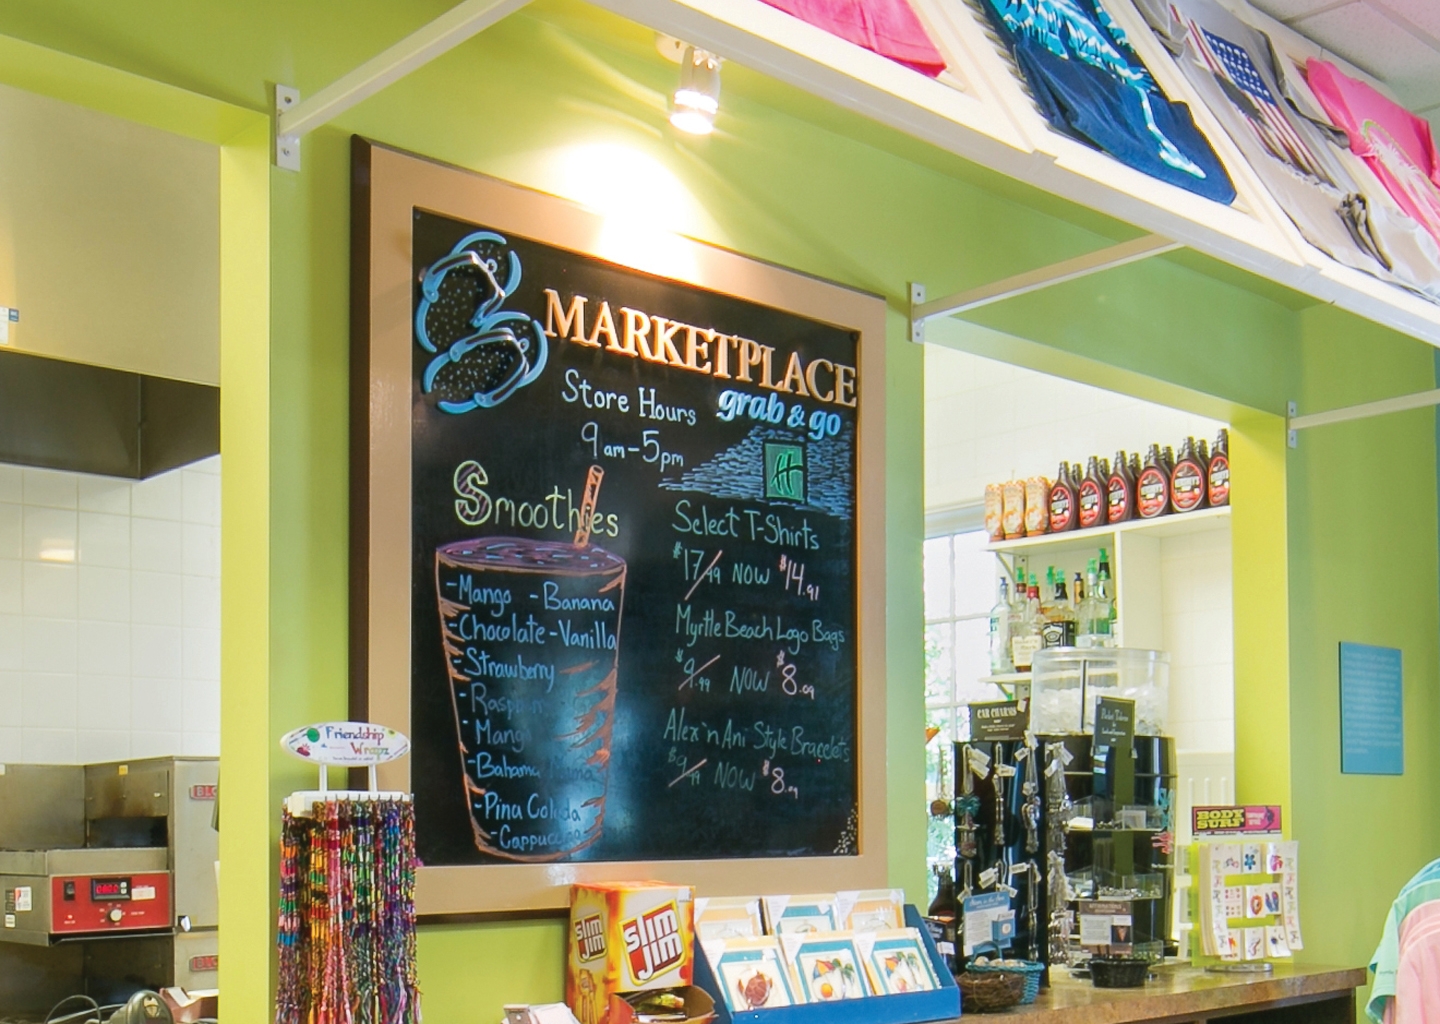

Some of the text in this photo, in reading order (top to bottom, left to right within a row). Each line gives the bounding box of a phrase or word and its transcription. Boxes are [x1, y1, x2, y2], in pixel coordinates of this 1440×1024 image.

[544, 288, 857, 408] MARKETPLACE
[562, 369, 696, 426] Store Hours
[717, 389, 841, 440] grab & go
[453, 460, 619, 539] Smoothies
[672, 499, 820, 550] Select T-Shirts
[732, 562, 770, 585] NOW
[675, 603, 846, 655] Myrtle Beach Logo Bags
[729, 665, 771, 695] NOW
[976, 706, 990, 719] CAR
[325, 726, 384, 746] Friendship
[664, 707, 699, 743] Alex
[722, 718, 748, 749] Ani
[753, 720, 788, 760] Style
[792, 725, 850, 763] Bracelets
[350, 742, 389, 760] Wrapz
[714, 761, 756, 792] NOW
[1196, 809, 1245, 820] BODY
[1196, 818, 1244, 831] SURF
[575, 918, 603, 941] slim
[624, 909, 679, 954] slim
[581, 934, 606, 959] jim
[637, 932, 683, 980] jim
